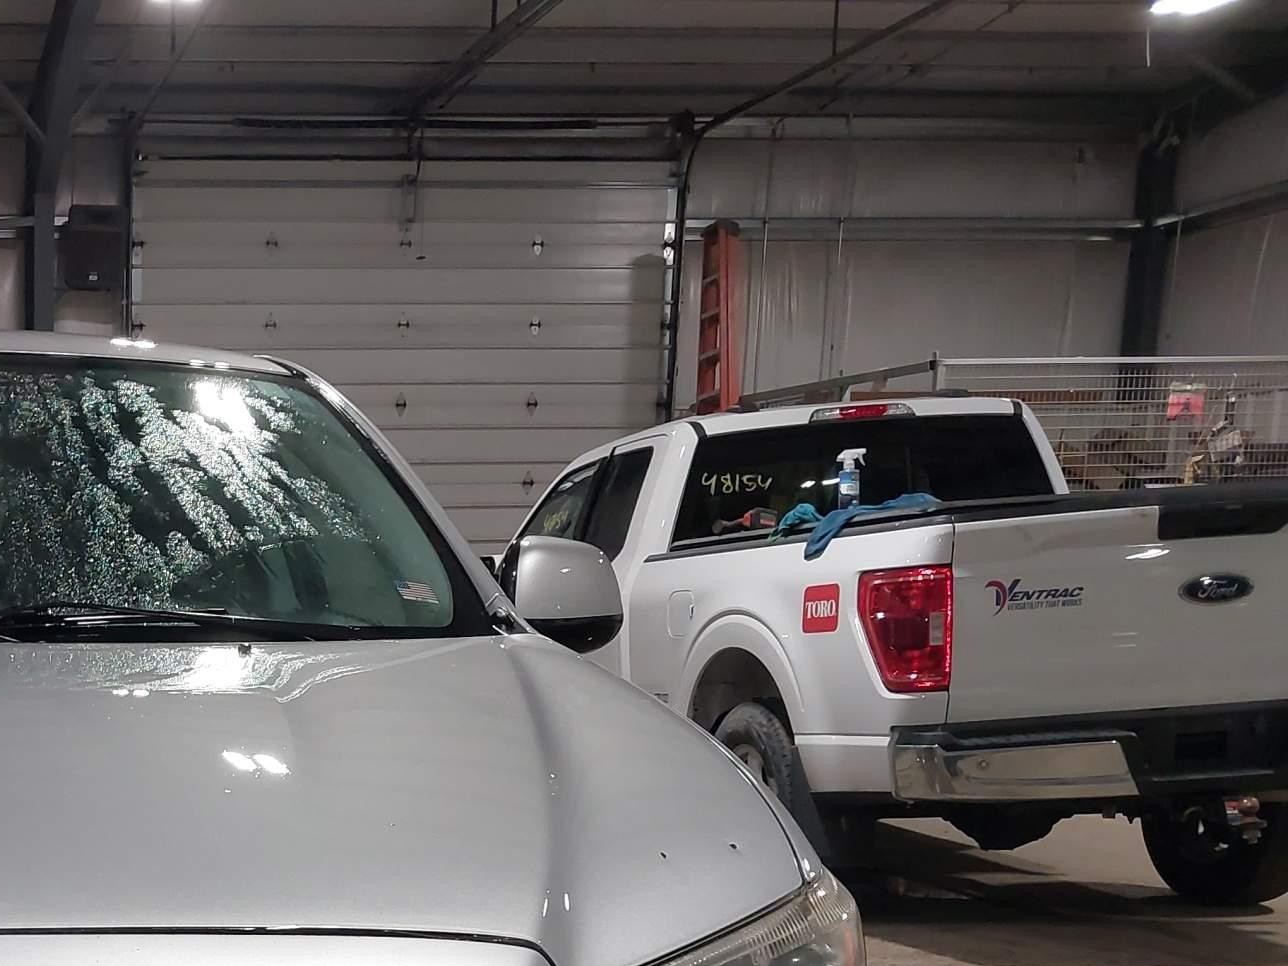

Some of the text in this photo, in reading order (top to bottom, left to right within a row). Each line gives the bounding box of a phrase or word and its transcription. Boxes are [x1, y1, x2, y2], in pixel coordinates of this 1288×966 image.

[701, 471, 773, 494] 48154
[985, 578, 1085, 616] VENTRAC
[805, 599, 836, 619] TORO
